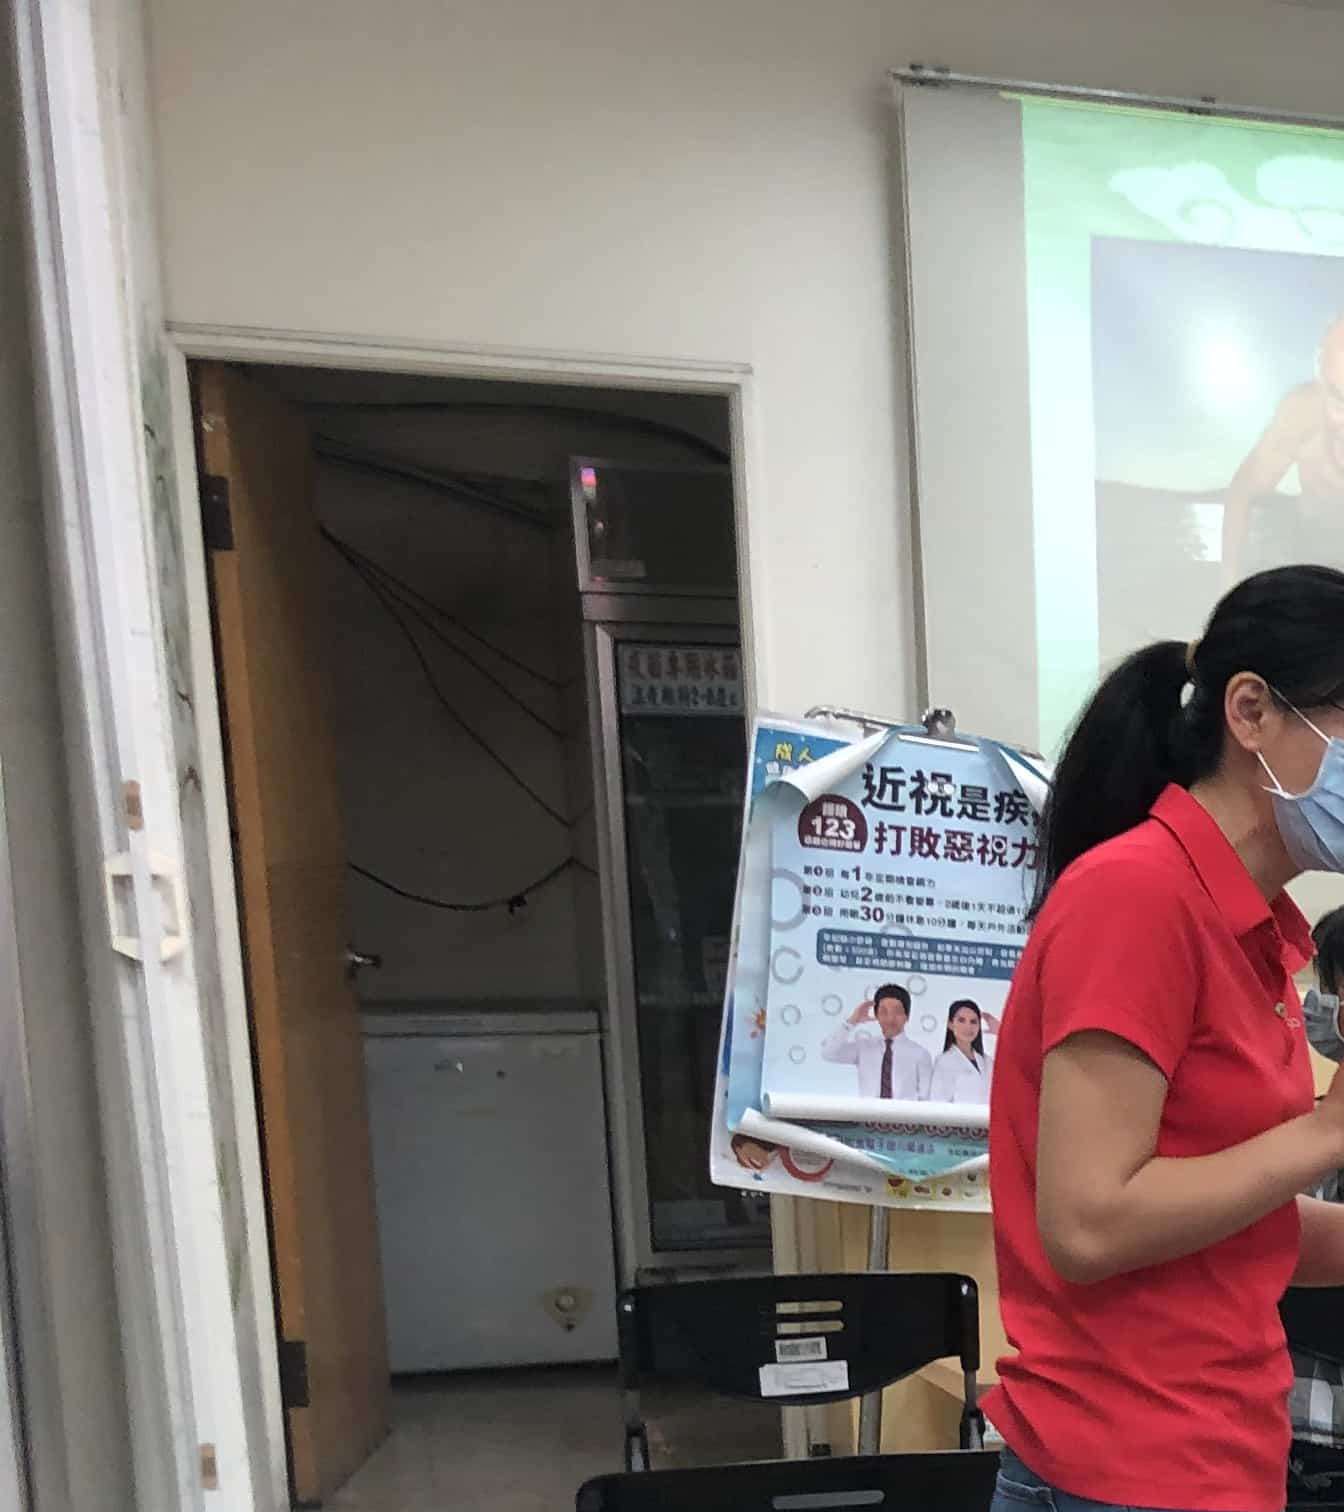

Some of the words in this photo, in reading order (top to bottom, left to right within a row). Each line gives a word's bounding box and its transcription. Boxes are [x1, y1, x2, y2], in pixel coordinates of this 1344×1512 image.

[861, 762, 1040, 829] 近視是疾
[811, 815, 856, 841] 123
